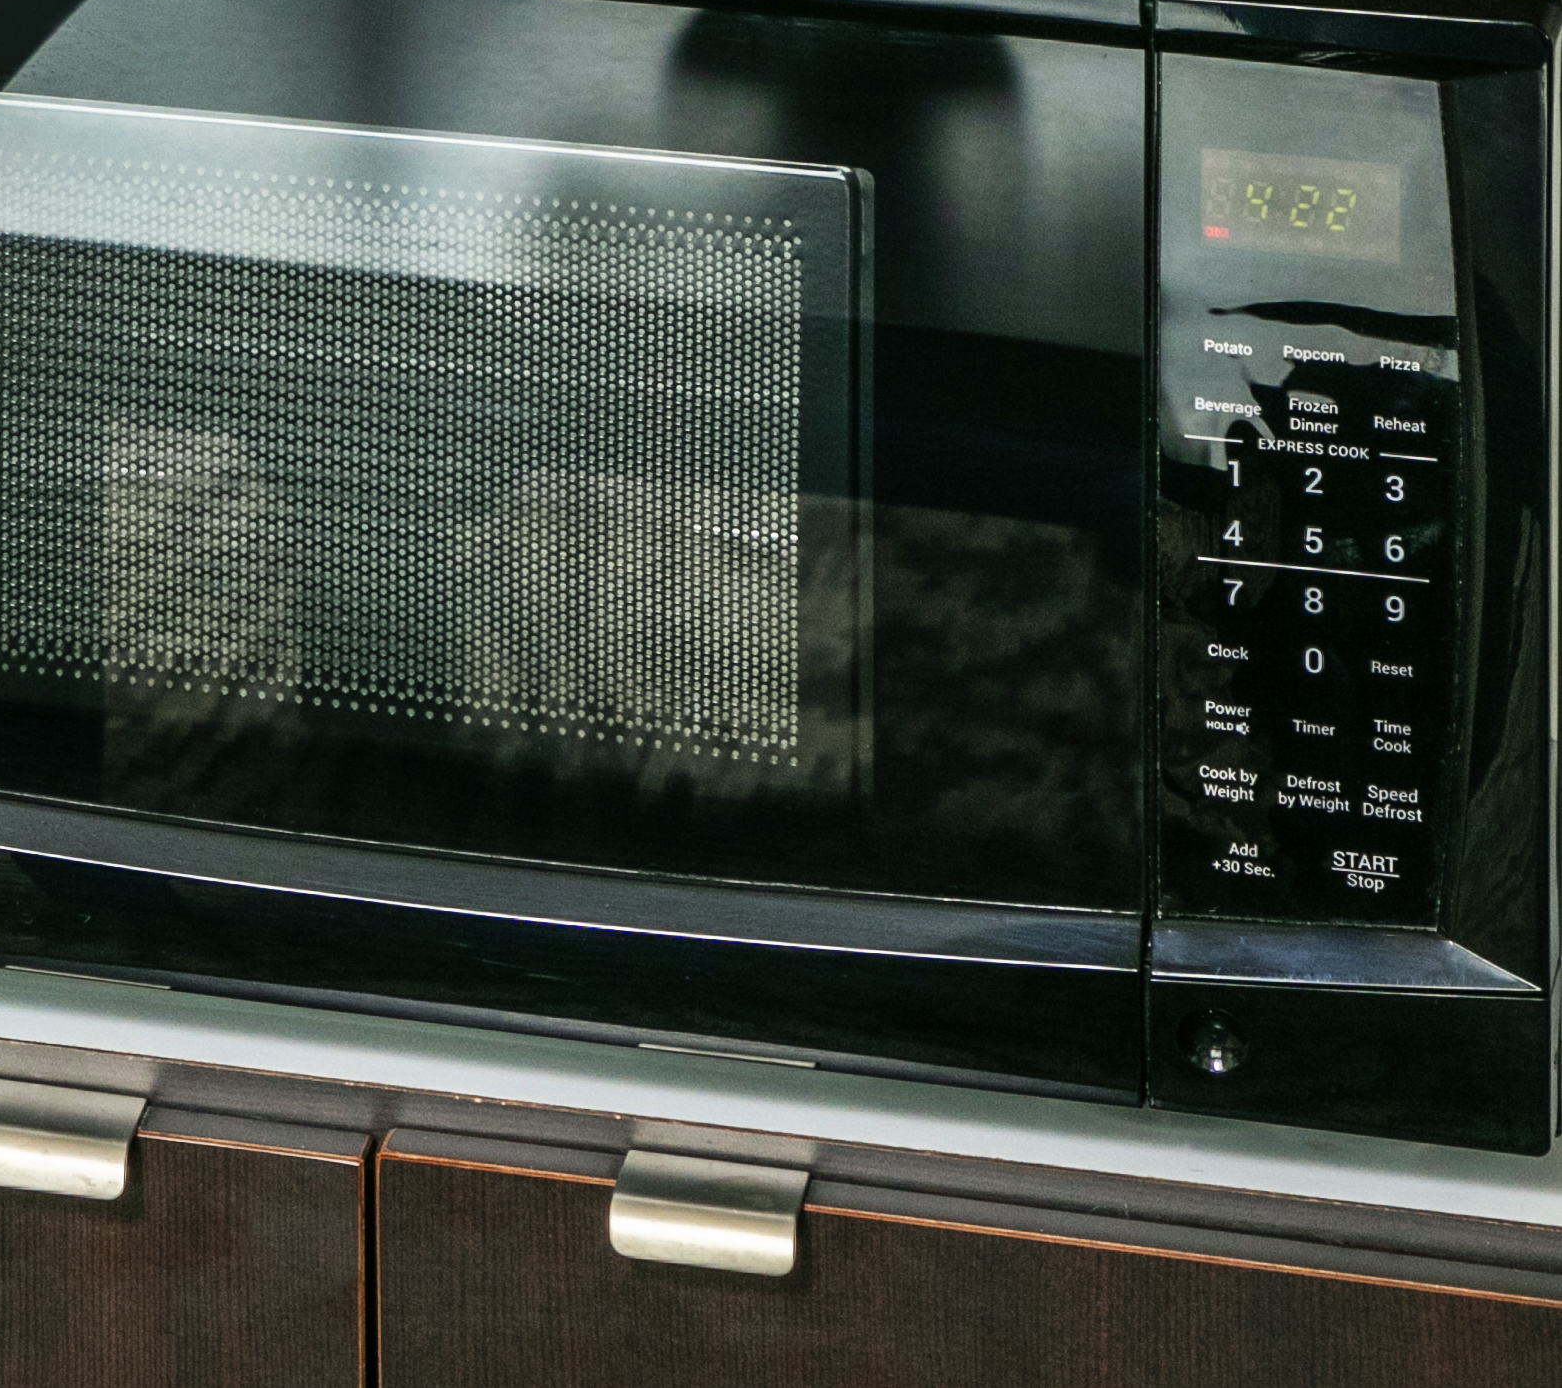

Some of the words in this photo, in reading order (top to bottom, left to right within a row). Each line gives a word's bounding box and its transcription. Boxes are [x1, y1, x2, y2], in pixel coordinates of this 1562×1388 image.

[1203, 338, 1253, 356] Potato
[1282, 345, 1345, 363] Popcorn
[1379, 355, 1421, 372] Pizza
[1194, 396, 1262, 418] Beverage
[1288, 397, 1339, 415] Frozen
[1289, 417, 1339, 435] Dinner
[1373, 415, 1427, 434] Reheat
[1257, 437, 1324, 455] EXPRESS
[1328, 444, 1370, 460] COOK
[1227, 459, 1240, 487] 1
[1304, 467, 1324, 495] 2
[1385, 475, 1405, 502] 3
[1222, 519, 1244, 547] 4
[1304, 526, 1323, 554] 5
[1384, 535, 1405, 563] 6
[1222, 578, 1244, 606] 7
[1304, 587, 1324, 614] 8
[1385, 595, 1405, 622] 9
[1207, 643, 1249, 661] Clock
[1304, 647, 1324, 674] 0
[1370, 659, 1414, 678] Reset
[1205, 700, 1252, 718] Power
[1205, 720, 1234, 732] HOLD
[1292, 718, 1336, 737] Timer
[1373, 718, 1412, 736] Time
[1373, 737, 1412, 754] Cook
[1198, 764, 1237, 782] Cook
[1240, 768, 1259, 786] by
[1286, 774, 1341, 793] Defrost
[1203, 783, 1255, 803] Weight
[1278, 791, 1296, 809] by
[1299, 794, 1351, 813] Weight
[1367, 784, 1418, 804] Speed
[1362, 802, 1423, 823] Defrost
[1228, 842, 1259, 858] Add
[1211, 859, 1241, 874] +30
[1244, 861, 1276, 878] Sec.
[1332, 850, 1399, 873] START
[1346, 873, 1385, 893] Stop
